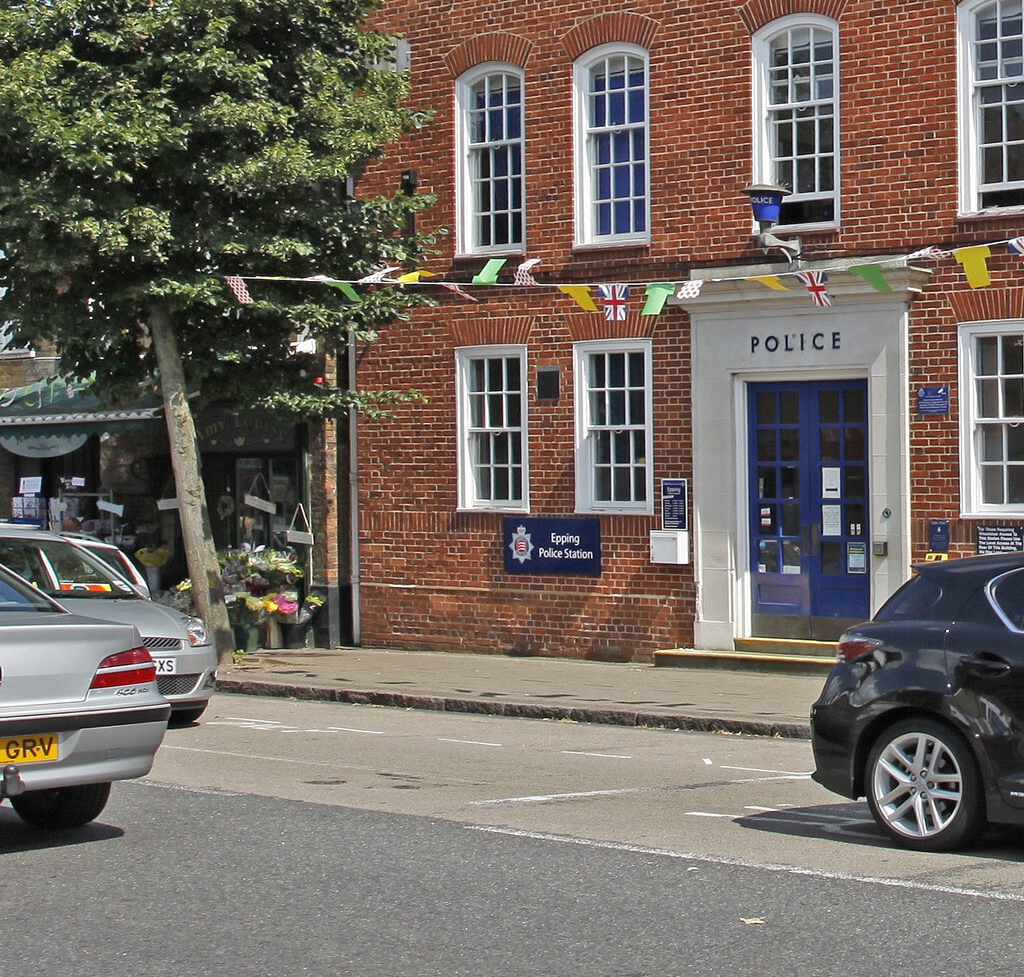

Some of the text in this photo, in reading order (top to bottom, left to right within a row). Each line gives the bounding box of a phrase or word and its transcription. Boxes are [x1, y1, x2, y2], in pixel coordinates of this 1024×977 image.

[751, 332, 841, 353] POLICE
[551, 533, 580, 546] Epping
[538, 548, 593, 559] Police Station
[5, 737, 53, 760] GRV
